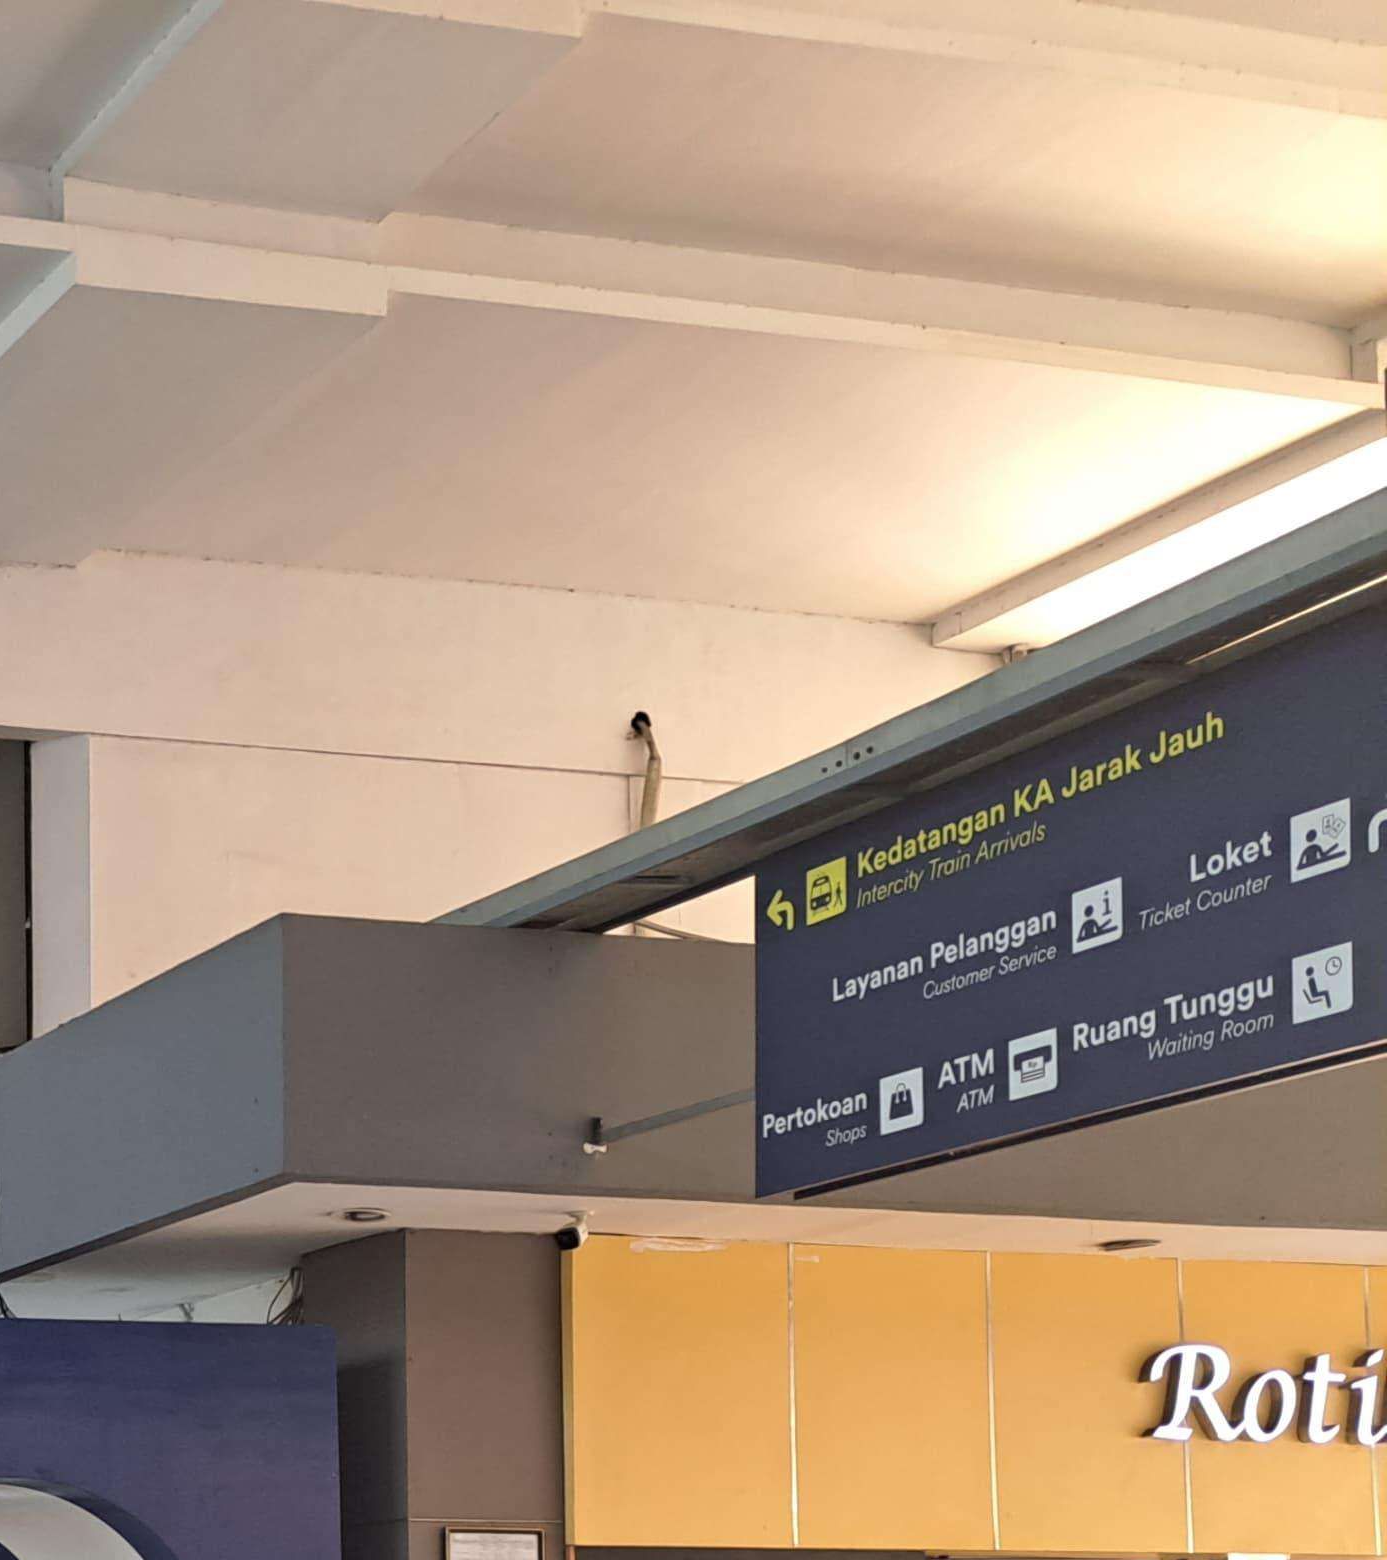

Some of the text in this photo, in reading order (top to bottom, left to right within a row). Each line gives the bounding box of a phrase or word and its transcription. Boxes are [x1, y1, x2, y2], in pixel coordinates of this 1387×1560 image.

[857, 711, 1225, 878] Kedatangan KA Jarak Jauh
[856, 820, 1046, 908] Intercity Train Arrivals
[1190, 831, 1273, 883] Loket
[1139, 874, 1273, 930] Ticket Counter
[832, 910, 1057, 1002] Layanan Pelanggan
[923, 945, 1058, 1000] Customer Service
[1073, 975, 1274, 1052] Ruang Tunggu
[1147, 1013, 1275, 1061] Waiting Room
[937, 1048, 995, 1089] ATM
[762, 1092, 868, 1138] Pertokoan
[956, 1084, 995, 1113] ATM
[825, 1125, 868, 1148] Shops
